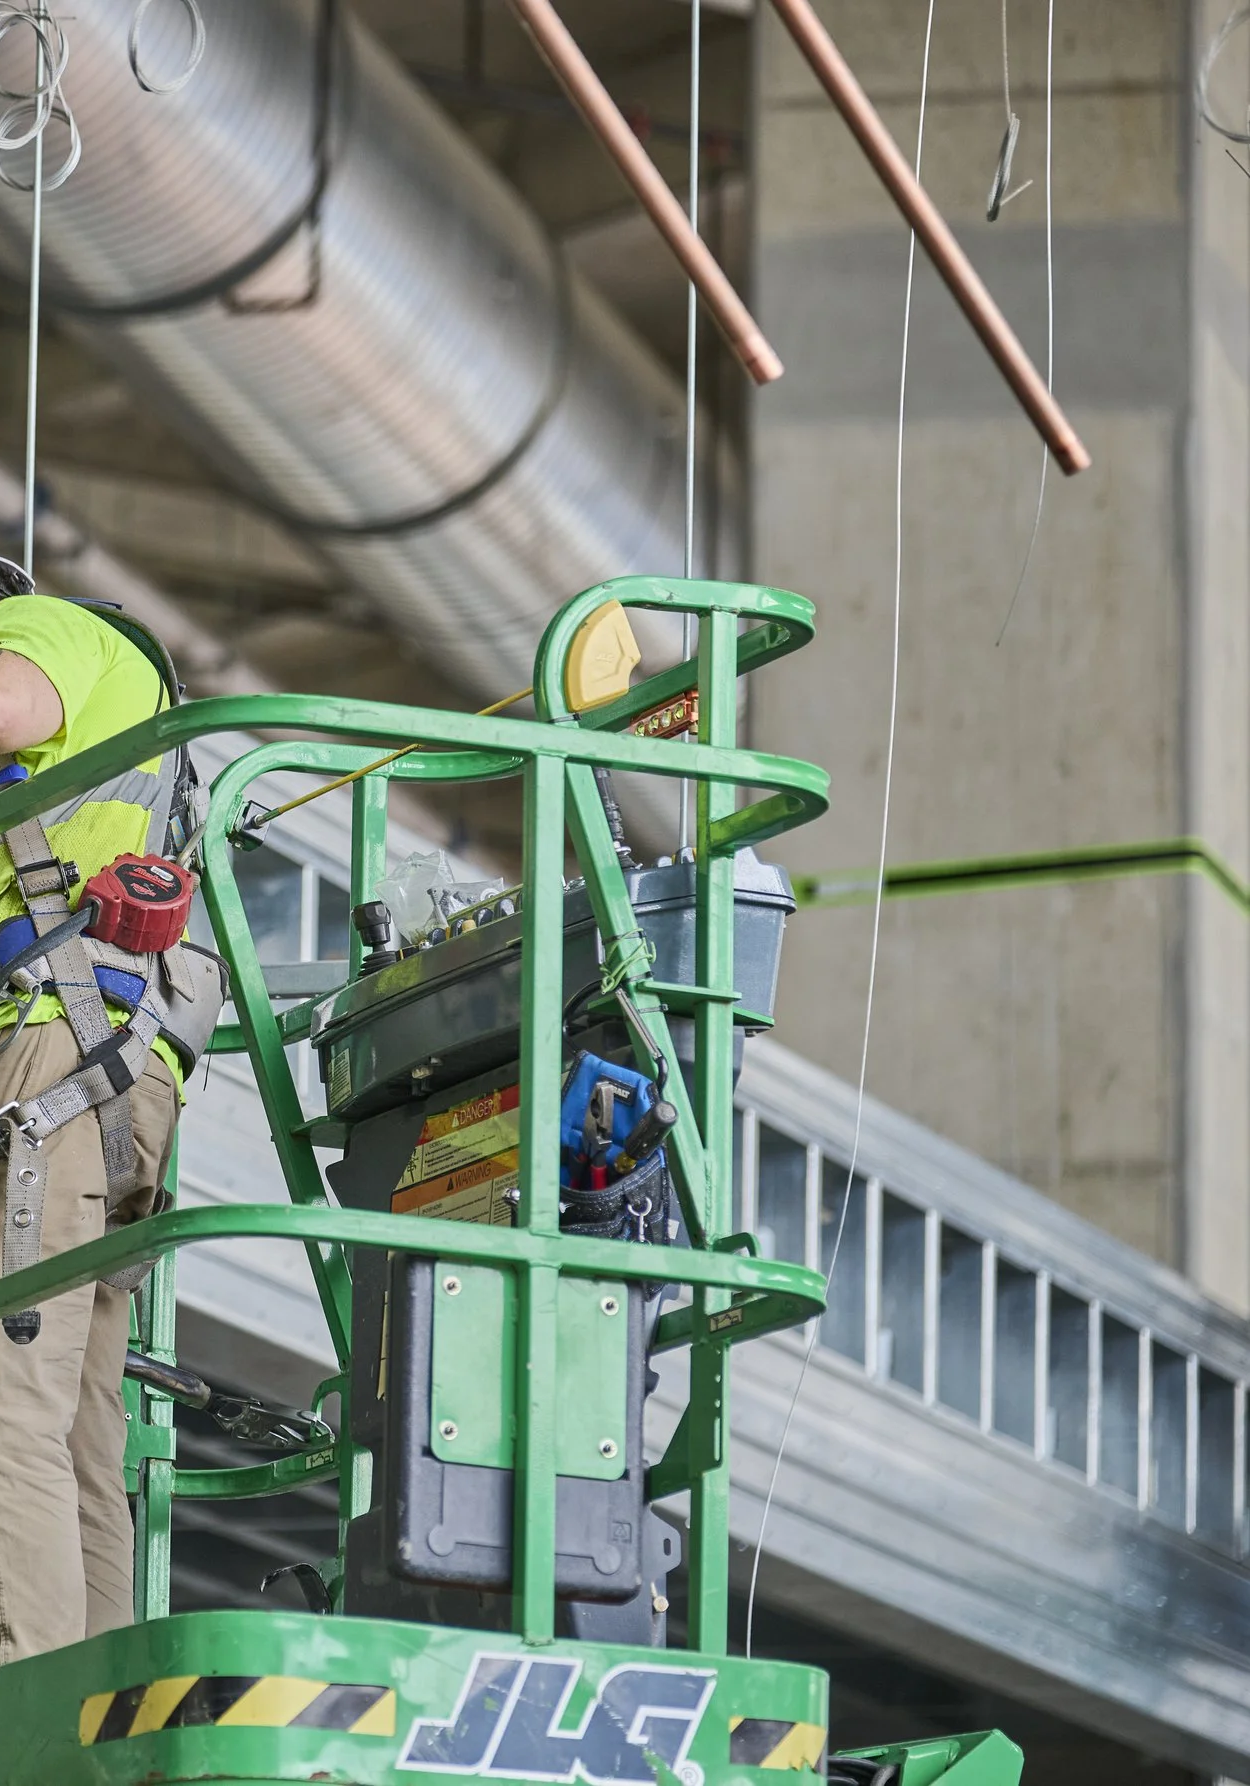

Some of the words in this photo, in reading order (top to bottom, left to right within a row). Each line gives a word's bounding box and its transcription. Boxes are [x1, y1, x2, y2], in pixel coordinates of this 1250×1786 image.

[460, 1099, 494, 1125] DANGER
[455, 1163, 492, 1189] WARNING
[395, 1651, 718, 1786] JLG
